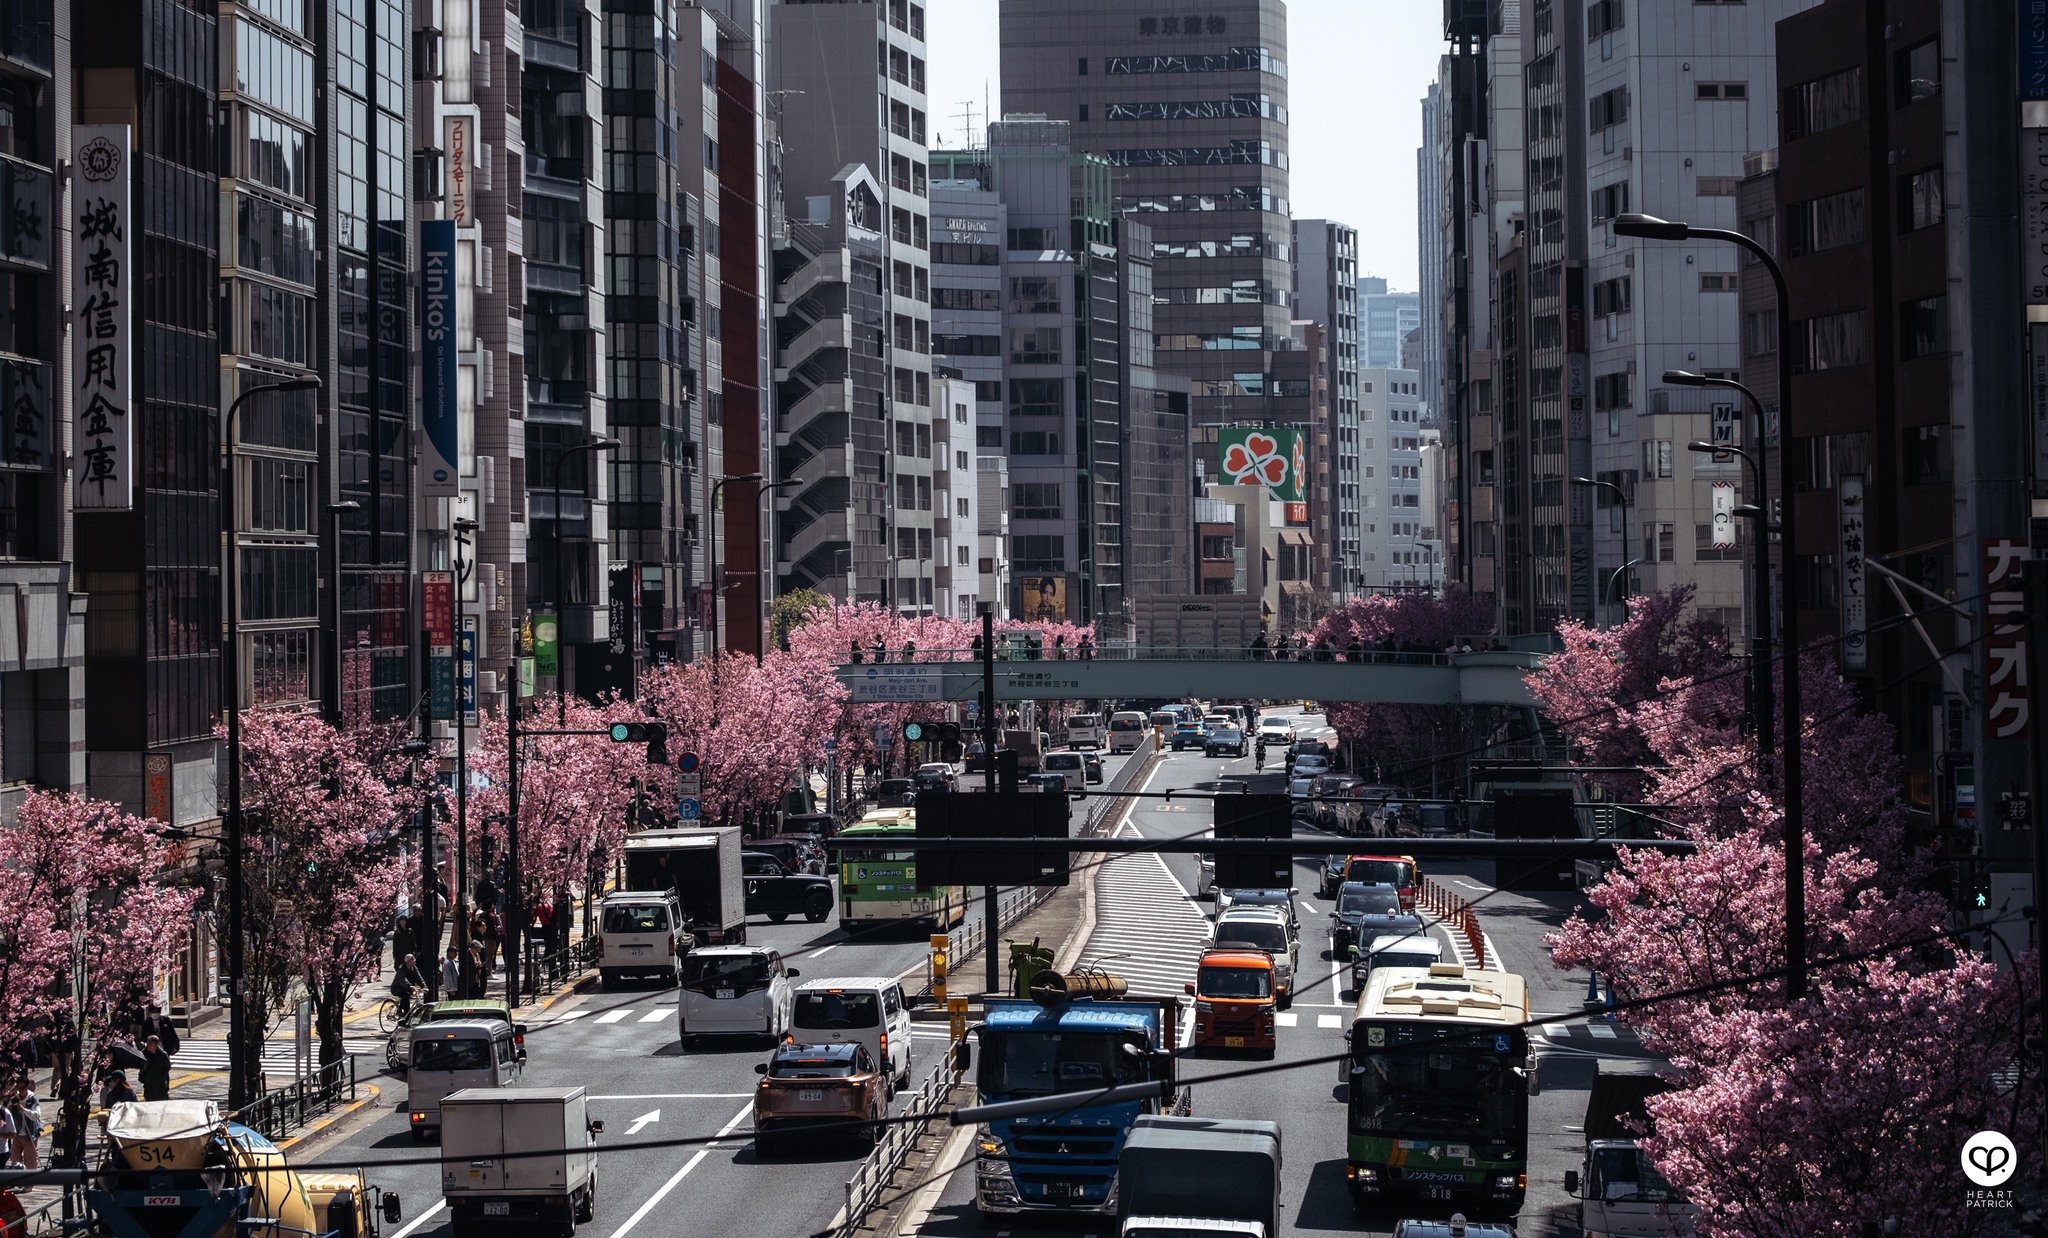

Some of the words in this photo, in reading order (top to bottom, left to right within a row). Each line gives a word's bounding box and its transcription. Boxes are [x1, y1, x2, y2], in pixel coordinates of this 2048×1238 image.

[1138, 15, 1226, 36] 東京建物
[427, 251, 450, 341] kinko's
[79, 196, 125, 497] 城南信用金庫
[437, 346, 444, 356] On
[437, 386, 445, 418] Solutions
[1293, 504, 1305, 519] ライフ
[1714, 512, 1728, 523] C
[429, 573, 445, 582] 2F
[609, 598, 625, 654] しょうがの湯
[431, 647, 444, 655] 1F
[858, 685, 937, 694] 渋谷区渋谷三丁目
[1008, 680, 1079, 688] 渋谷区渋谷三丁目
[682, 803, 692, 817] P
[1360, 1117, 1382, 1130] G818
[139, 1145, 175, 1163] 514
[1407, 1171, 1466, 1183] ノンステップバス
[1431, 1188, 1451, 1199] 818
[148, 1197, 177, 1205] KYB
